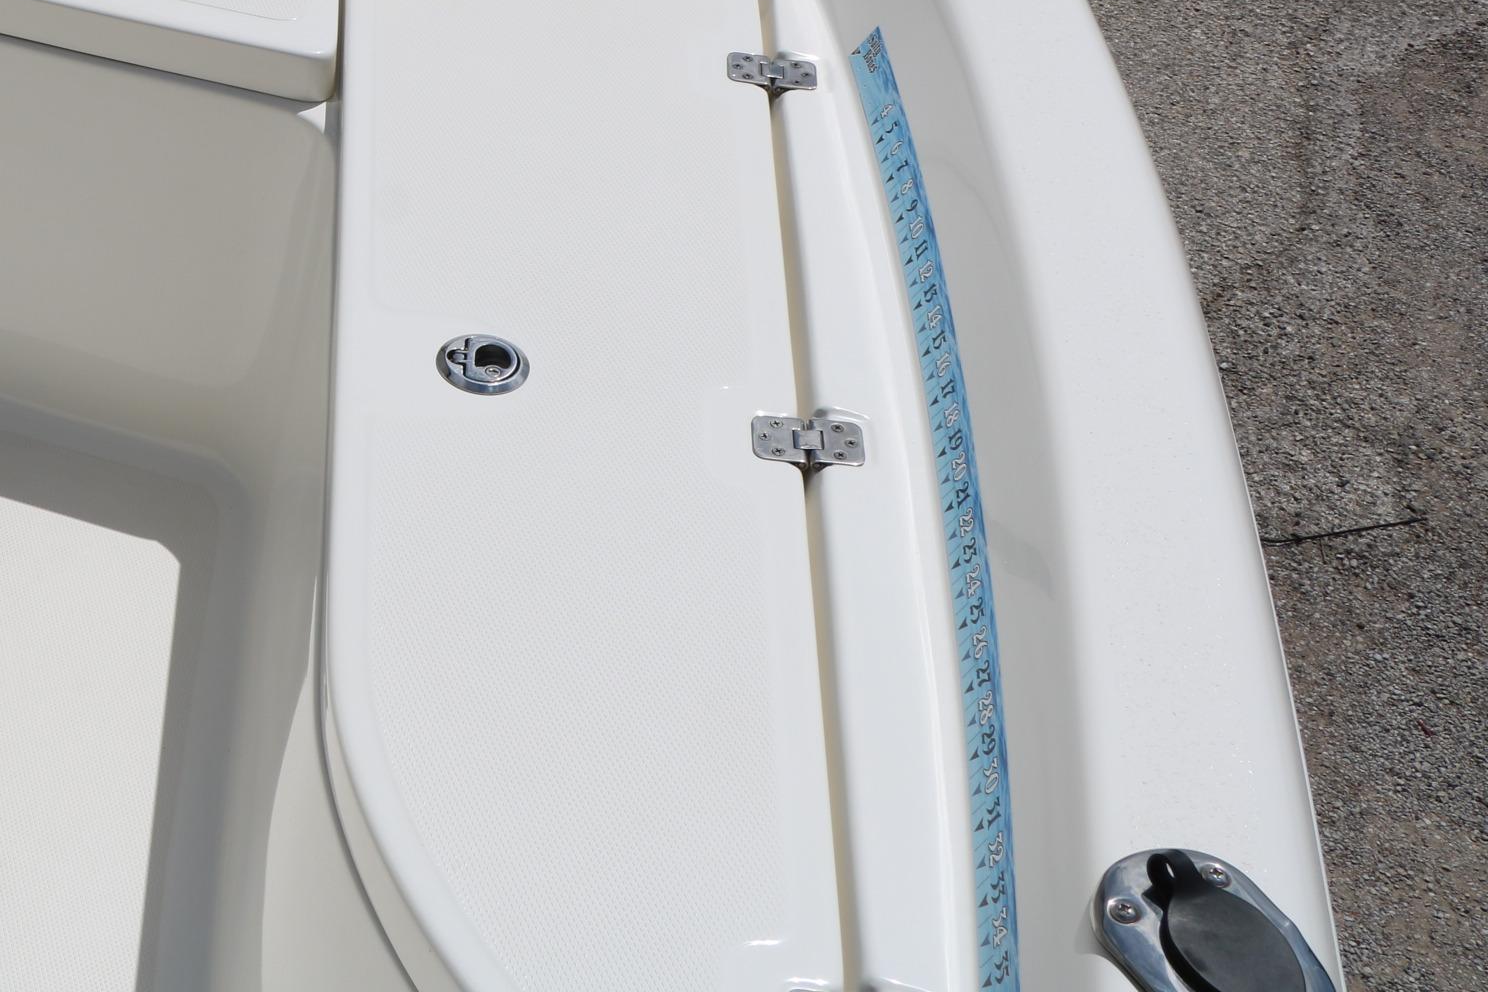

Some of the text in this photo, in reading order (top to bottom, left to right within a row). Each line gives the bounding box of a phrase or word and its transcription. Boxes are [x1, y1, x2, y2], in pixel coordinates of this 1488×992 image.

[880, 103, 1010, 984] 4 5 6 7 8 9 10 11 12 13 14 15 16 17 18 19 20 21 22 23 24 25 26 27 28 29 30 31 32 33 34 35
